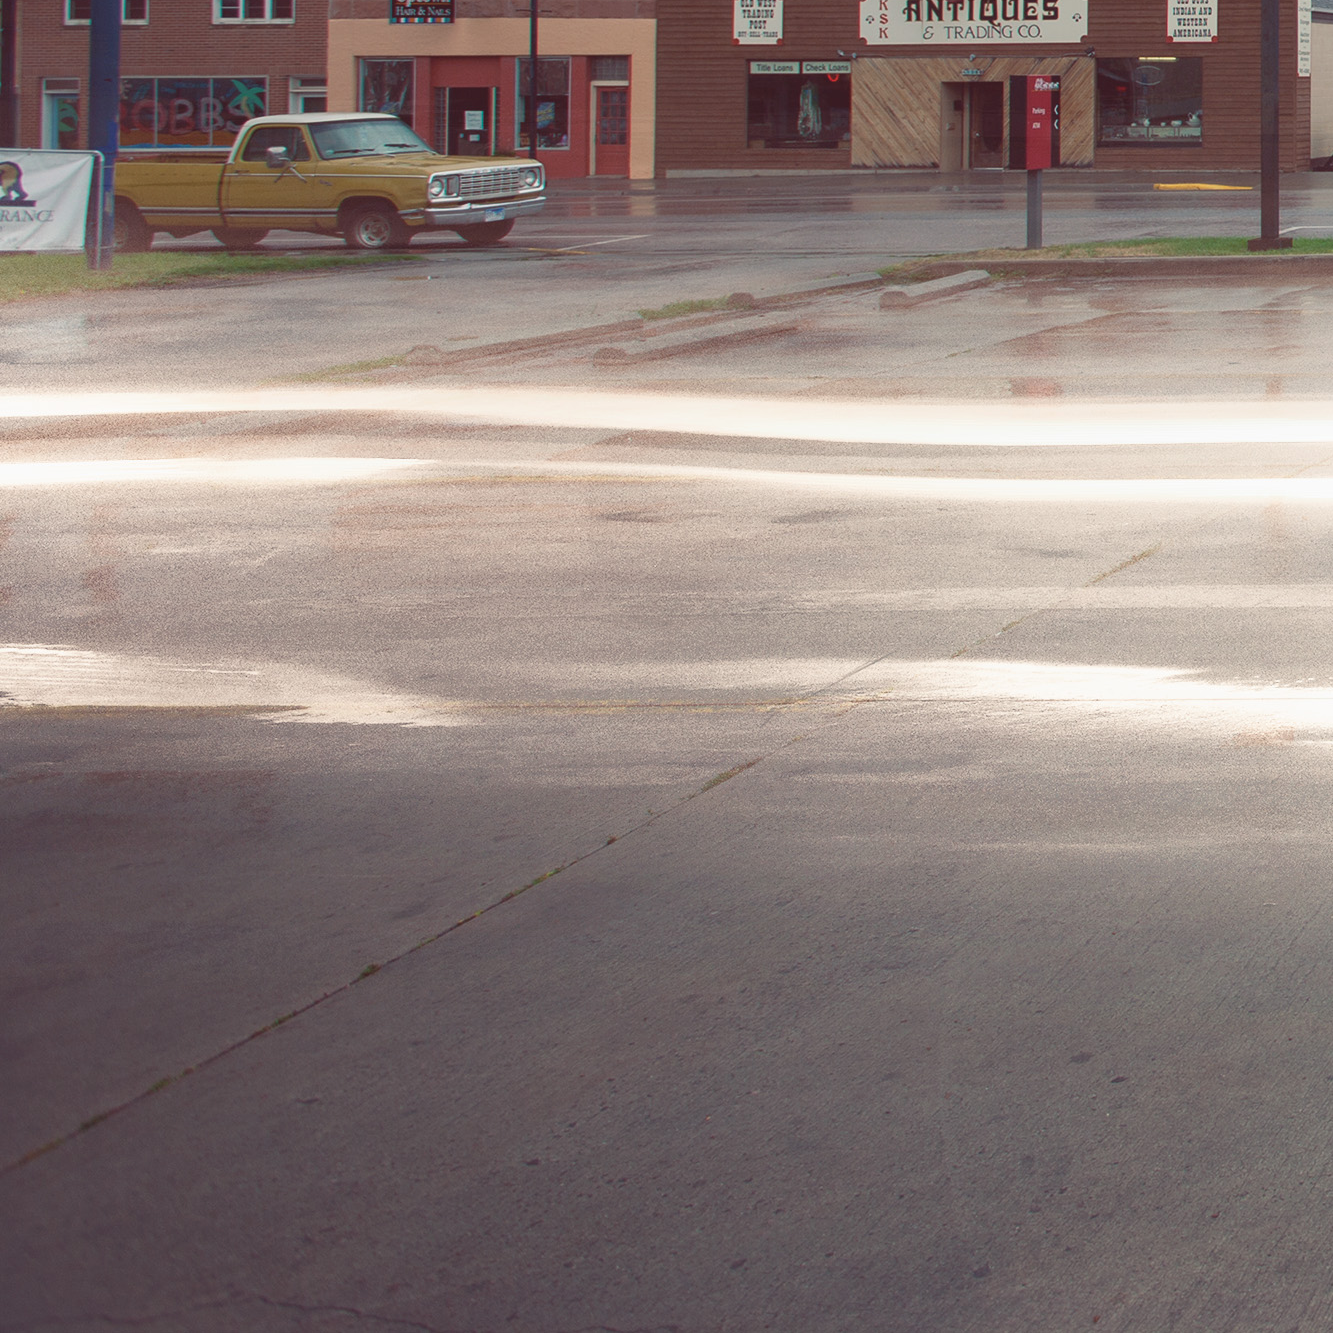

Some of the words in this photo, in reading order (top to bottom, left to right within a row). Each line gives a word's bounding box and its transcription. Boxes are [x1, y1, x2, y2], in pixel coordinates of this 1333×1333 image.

[418, 6, 426, 16] &
[742, 9, 774, 19] TRADING
[1172, 7, 1197, 16] INDIAN
[1199, 7, 1213, 16] AND
[749, 20, 767, 29] POST
[1176, 18, 1208, 27] WESTERN
[922, 26, 935, 40] &
[944, 25, 1013, 39] TRADING
[1018, 24, 1043, 39] CO.
[1172, 29, 1212, 38] AMERICANA
[756, 63, 771, 72] Title
[773, 63, 794, 72] Loans
[805, 63, 826, 72] Check
[828, 63, 849, 72] Loans
